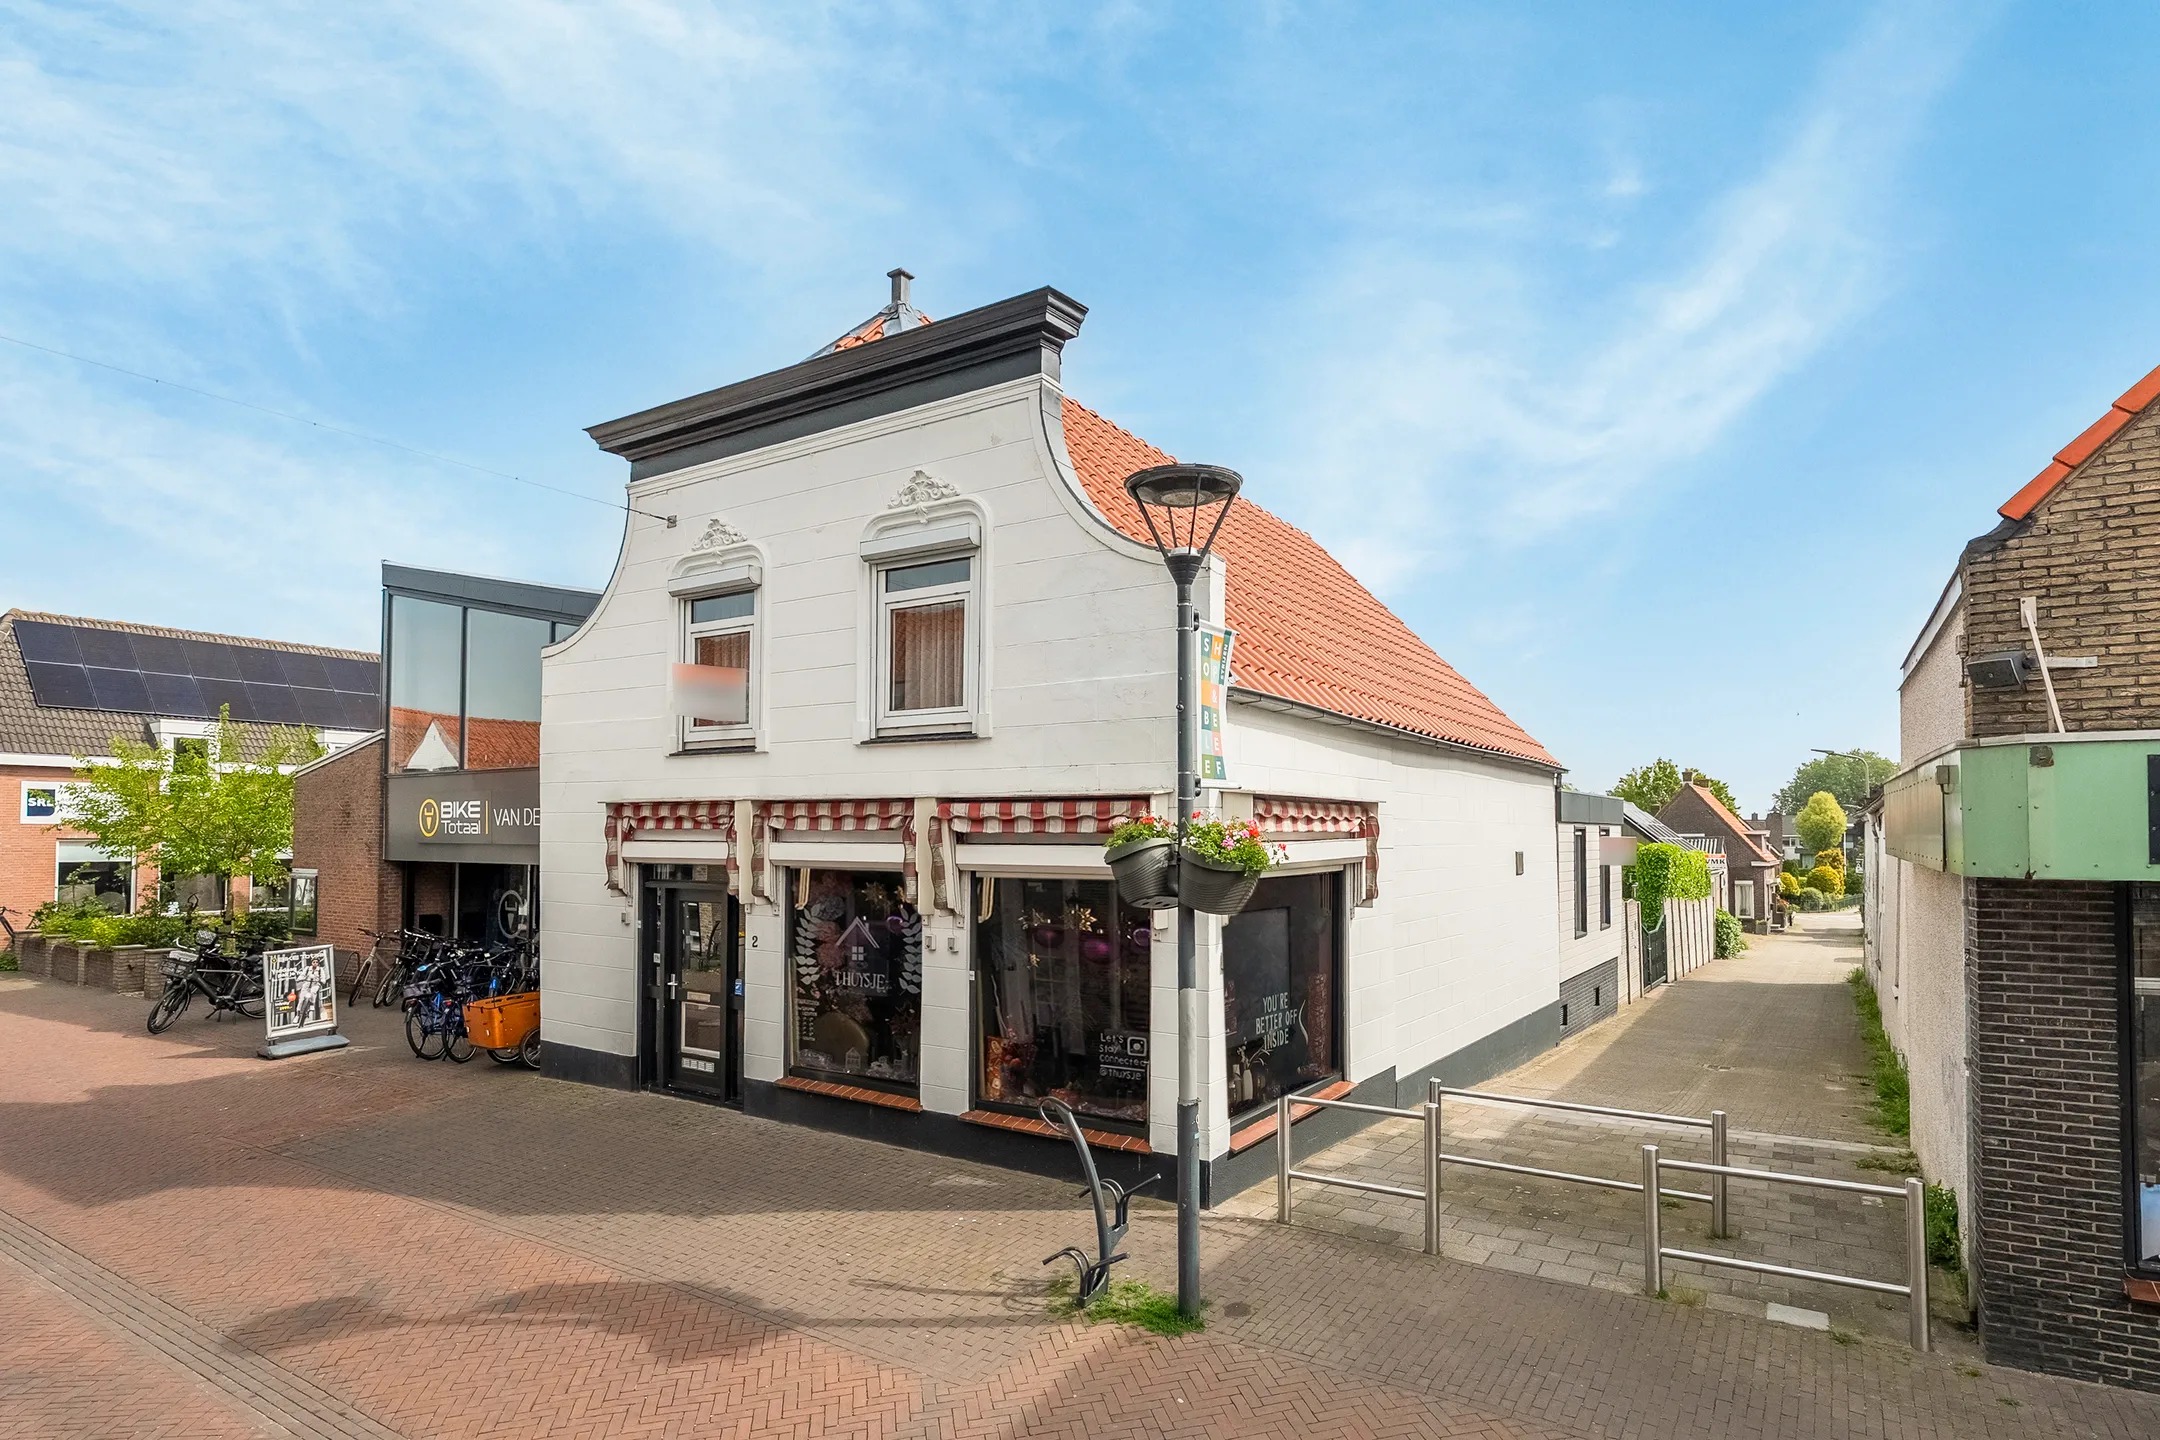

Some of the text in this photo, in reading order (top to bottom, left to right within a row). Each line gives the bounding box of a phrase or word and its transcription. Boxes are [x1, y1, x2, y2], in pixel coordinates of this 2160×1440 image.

[440, 801, 481, 819] BIKE
[493, 808, 520, 826] VAN
[440, 820, 481, 835] Totaal
[751, 935, 759, 948] 2
[1262, 992, 1289, 1014] YOU'RE
[1255, 1009, 1298, 1035] BETTER OFF
[1263, 1028, 1289, 1050] INSIDE
